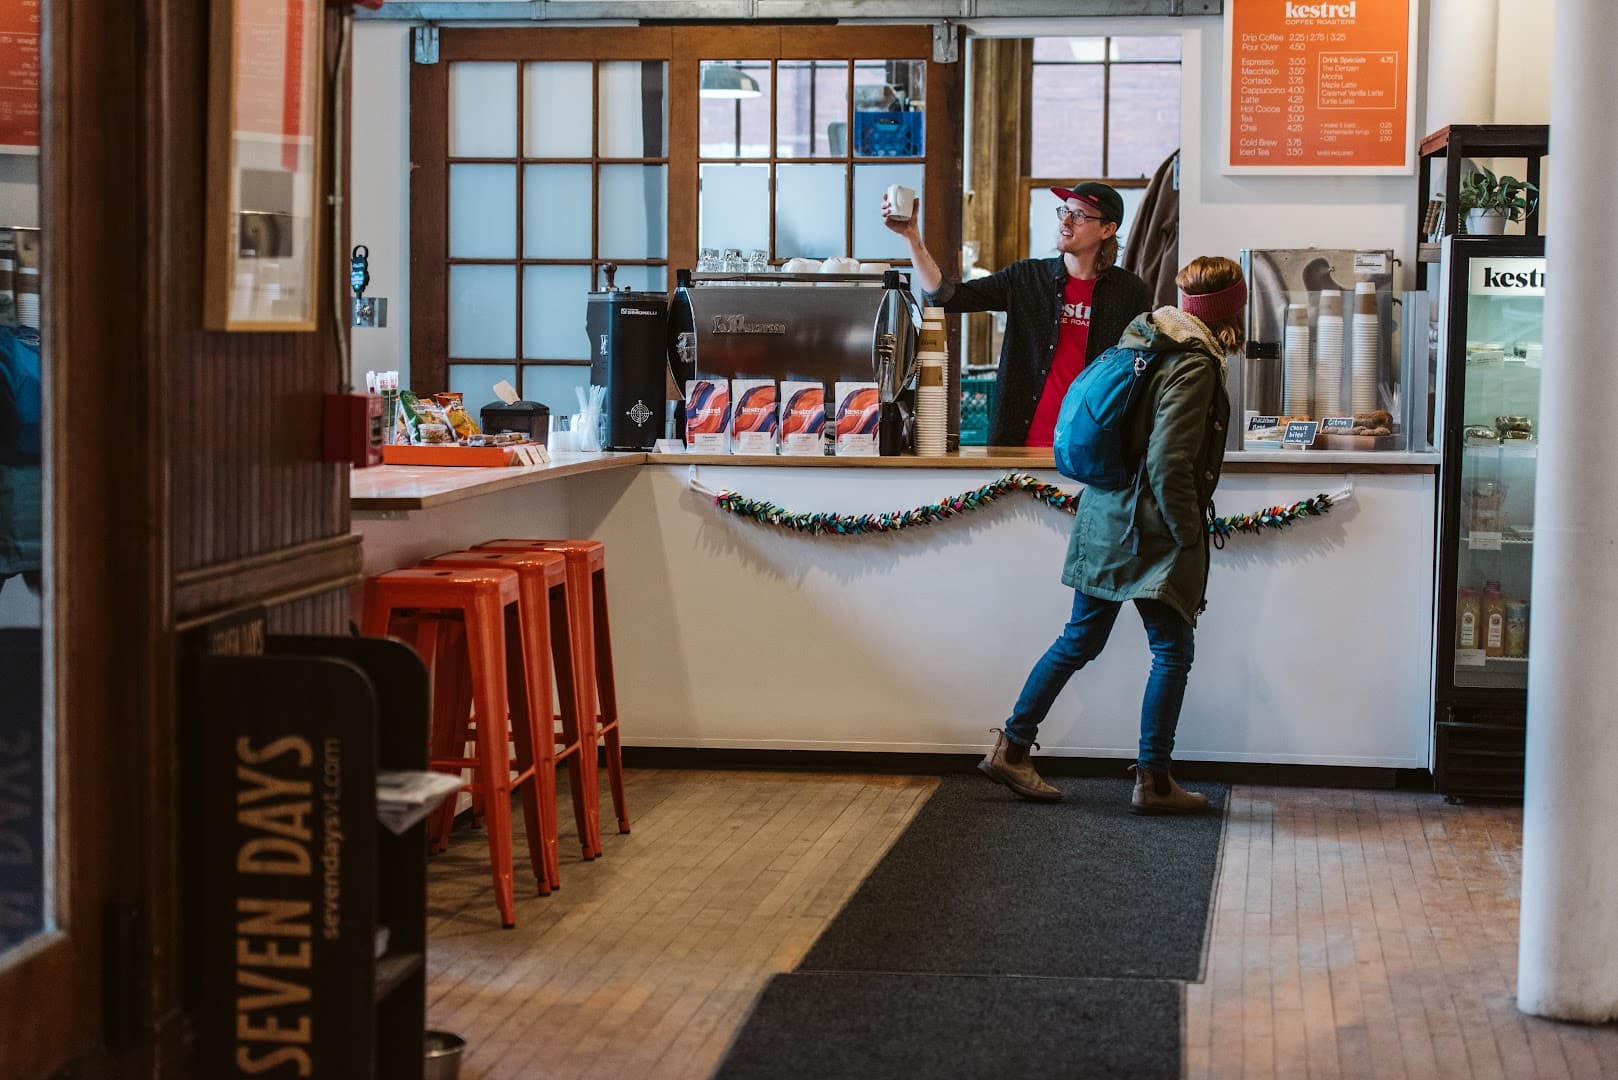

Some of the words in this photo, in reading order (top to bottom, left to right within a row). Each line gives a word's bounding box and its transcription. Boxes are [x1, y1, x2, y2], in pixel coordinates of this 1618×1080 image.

[1241, 58, 1274, 66] Espresso
[1285, 1, 1356, 18] kestrel
[236, 735, 313, 876] DAYS
[322, 737, 344, 940] sevendaysvt.com
[236, 898, 312, 1077] SEVEN
